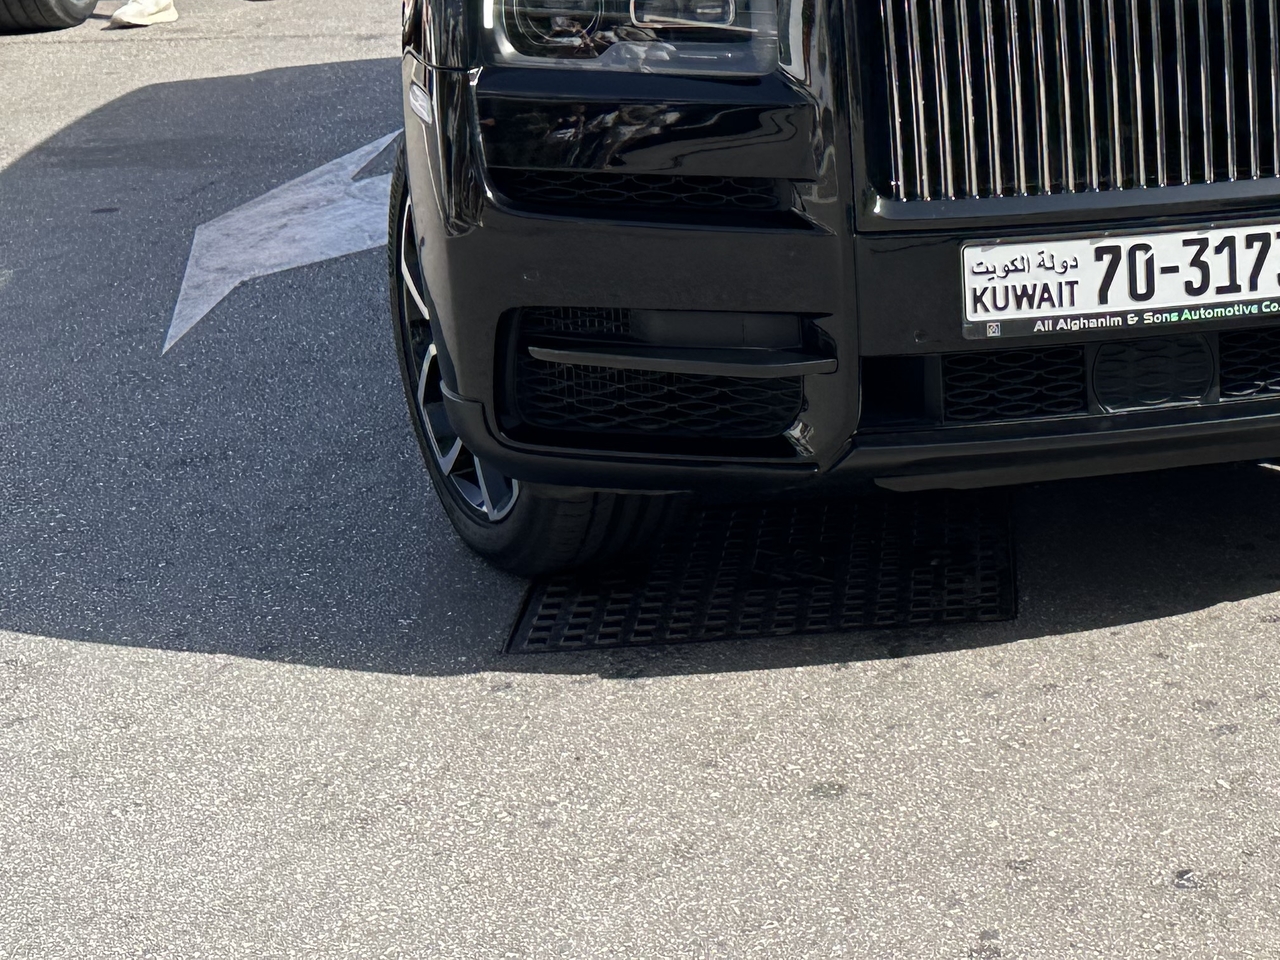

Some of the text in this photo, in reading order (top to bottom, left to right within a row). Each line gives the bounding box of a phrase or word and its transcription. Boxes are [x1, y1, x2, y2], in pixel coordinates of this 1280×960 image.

[971, 248, 1080, 282] دولة الكويت
[971, 280, 1080, 315] KUWAIT
[1056, 315, 1123, 332] Alghanim
[1127, 313, 1139, 325] &
[1143, 312, 1179, 324] Sons
[1180, 304, 1259, 322] Automotive
